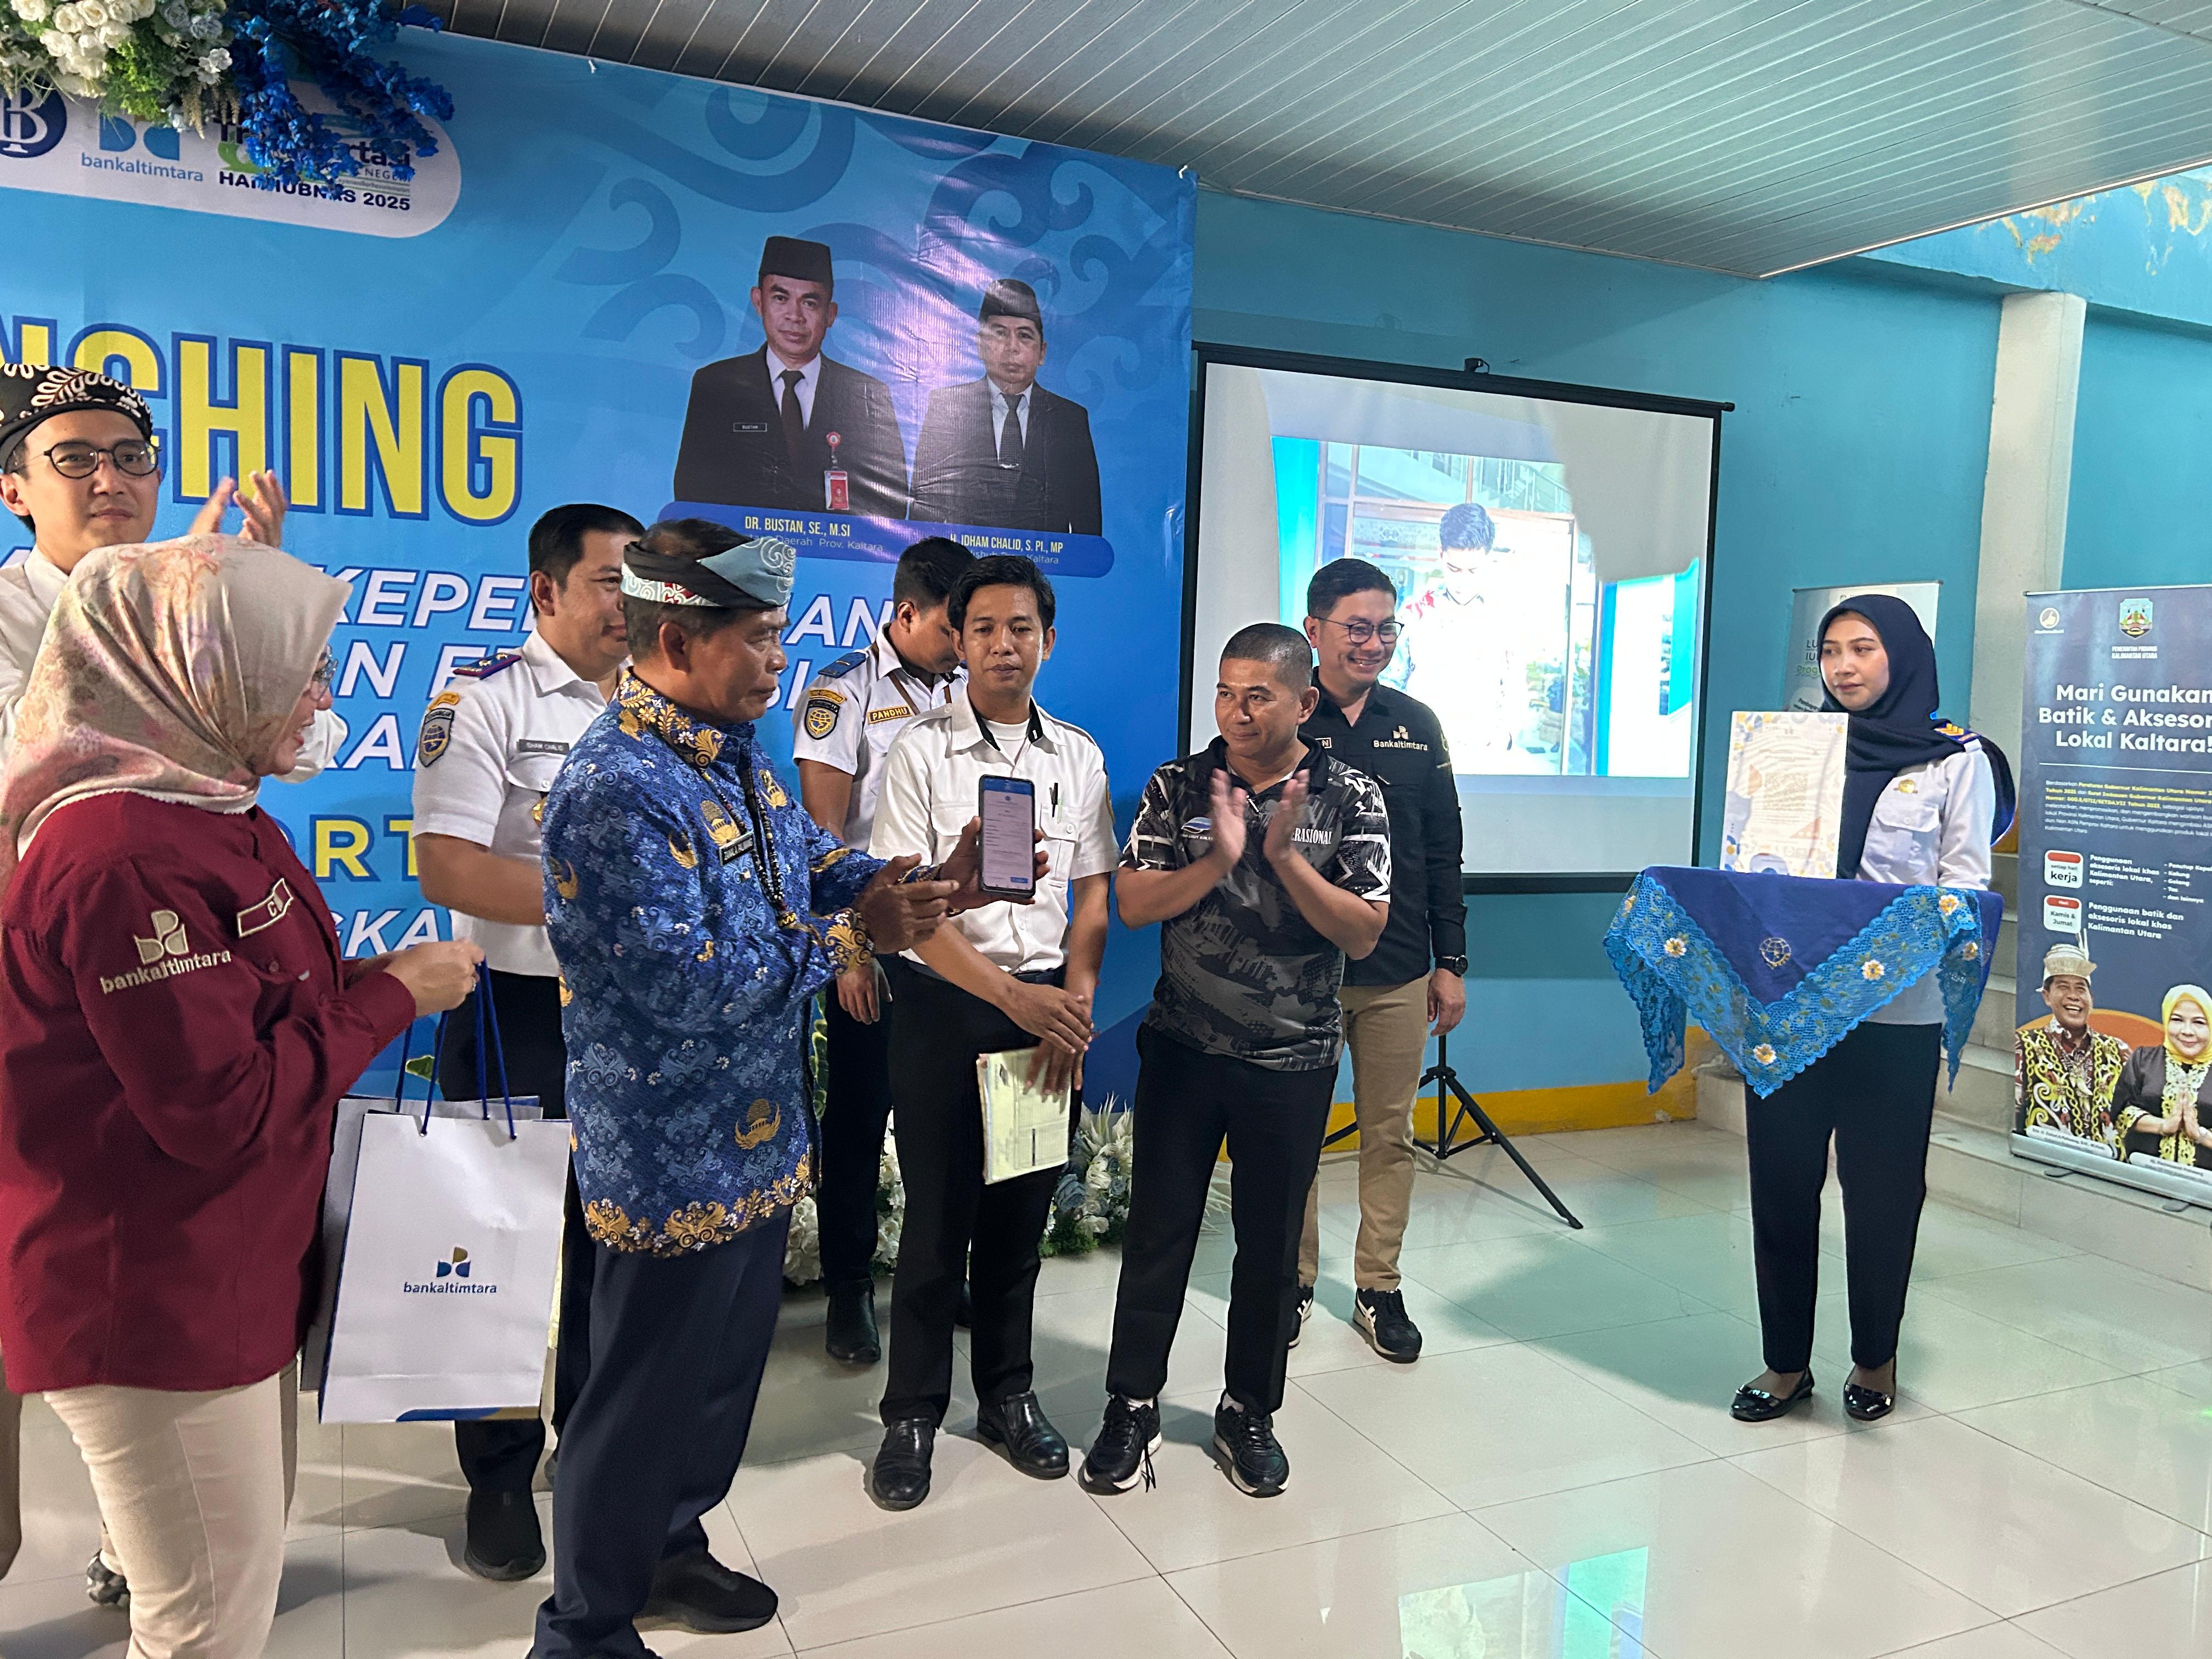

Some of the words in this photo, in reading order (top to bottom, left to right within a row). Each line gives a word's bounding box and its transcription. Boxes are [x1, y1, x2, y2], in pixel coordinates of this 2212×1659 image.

[81, 153, 204, 182] bankaltimtara
[219, 171, 356, 203] HAUBNS
[363, 193, 410, 211] 2025
[0, 314, 523, 528] HING
[745, 516, 761, 530] DR.
[765, 517, 806, 535] BUSTAN,
[809, 521, 826, 537] SE.,
[830, 523, 850, 537] M.SI
[776, 535, 812, 546] Daerah
[819, 538, 844, 549] Prov.
[848, 540, 883, 552] Kaltara
[961, 534, 989, 548] IDHAM
[991, 537, 1023, 552] CHALID,
[1025, 539, 1034, 551] S.
[1050, 541, 1063, 554] MP
[1797, 665, 1819, 676] Prog
[2056, 682, 2104, 701] Mari
[2111, 685, 2212, 703] Gunakan
[872, 707, 907, 721] PANDHU
[2039, 706, 2096, 725] Batik
[2101, 708, 2118, 725] &
[2123, 708, 2212, 729] Aksesor
[1373, 740, 1428, 752] Bankaltimtara
[2056, 730, 2112, 749] Lokal
[2120, 732, 2212, 753] Kaltara!
[2090, 854, 2132, 864] Penggunaan
[2090, 863, 2120, 872] aksesoris
[2051, 871, 2077, 883] kerja
[2090, 870, 2128, 880] Kalimantan
[2089, 902, 2140, 915] Penggunaan
[2142, 909, 2164, 919] batik
[2166, 912, 2184, 921] dan
[2088, 913, 2125, 924] aksesoris
[2128, 917, 2149, 927] lokal
[2151, 921, 2172, 930] khas
[2088, 923, 2135, 935] Kalimantan
[2137, 929, 2162, 939] Utara
[100, 949, 232, 994] bankaltimtara
[403, 1282, 497, 1294] bankaltimtara
